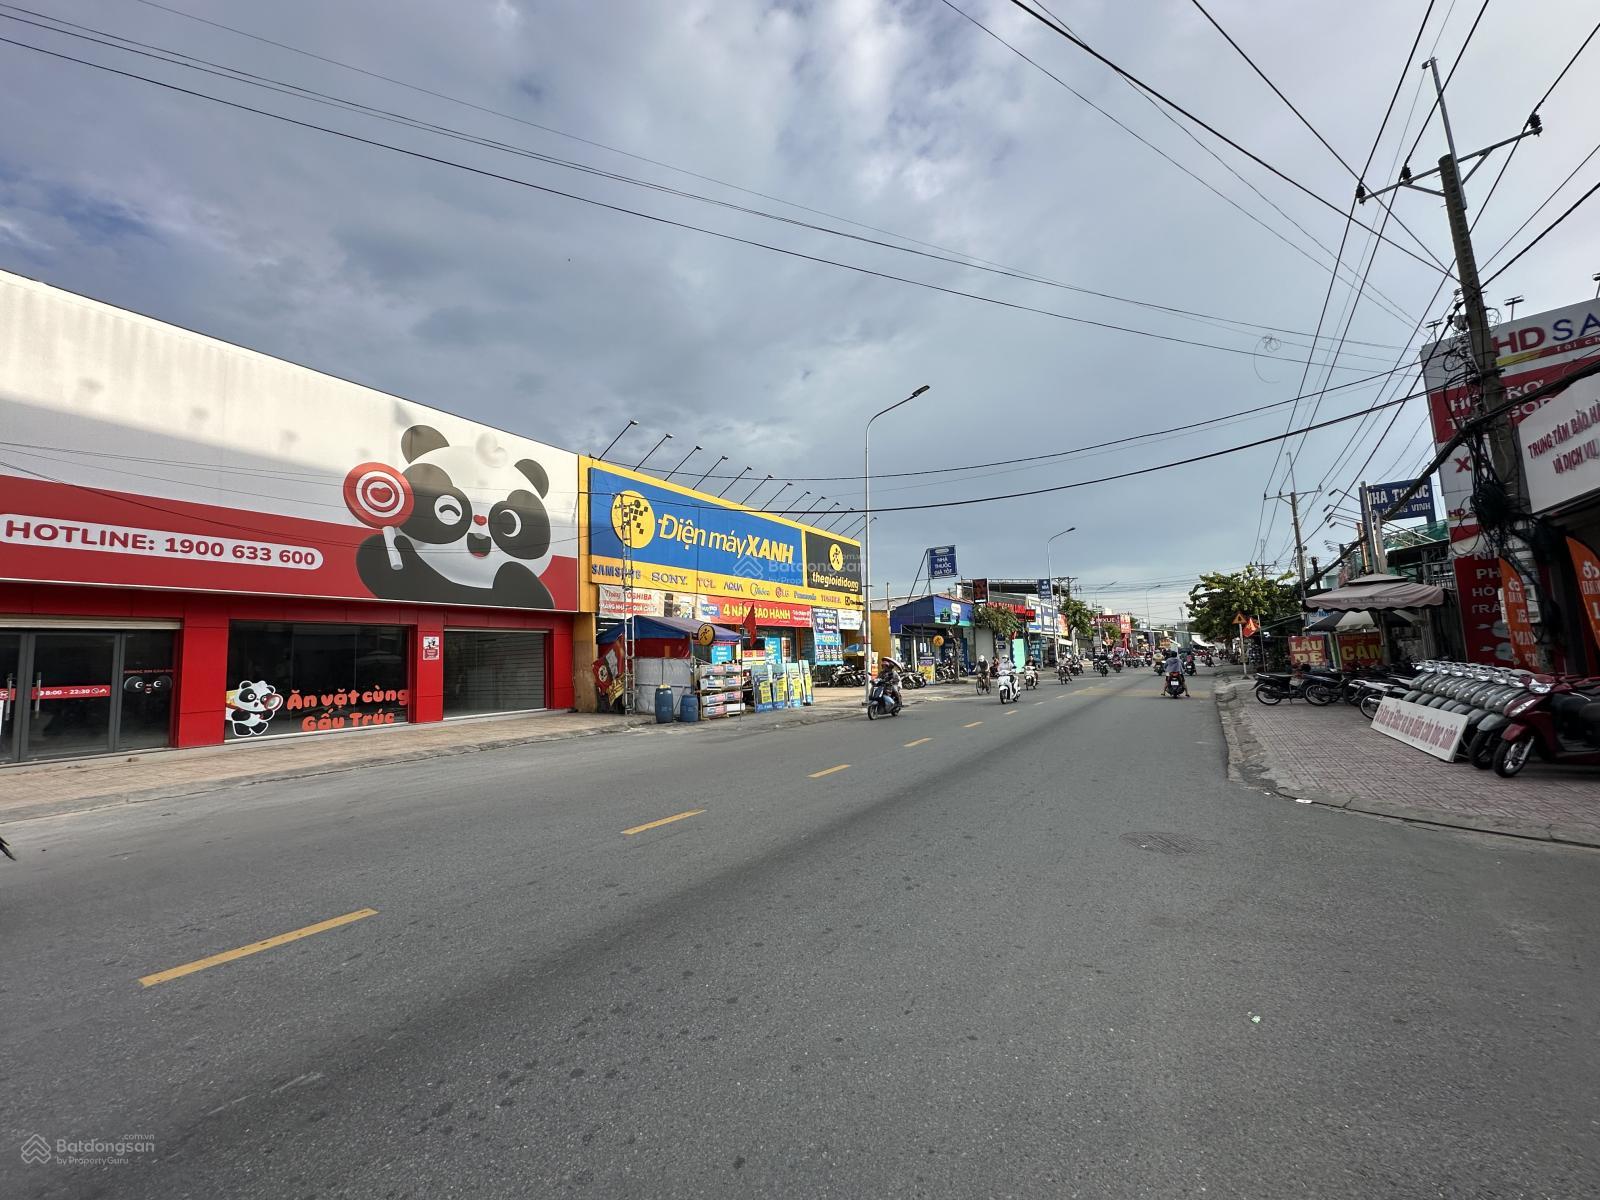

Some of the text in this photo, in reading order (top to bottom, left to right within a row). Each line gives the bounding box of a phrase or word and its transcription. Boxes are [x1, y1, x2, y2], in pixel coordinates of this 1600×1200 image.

[1491, 326, 1546, 353] HD
[1528, 433, 1554, 459] TRUNG
[1411, 502, 1431, 513] VINH
[4, 519, 316, 566] HOTLINE: 1900 633 600
[656, 513, 707, 550] Điện
[723, 603, 731, 616] 4
[769, 606, 791, 620] HÀNH
[286, 684, 409, 711] Ăn vặt cùng
[301, 708, 395, 731] Gấu Trúc
